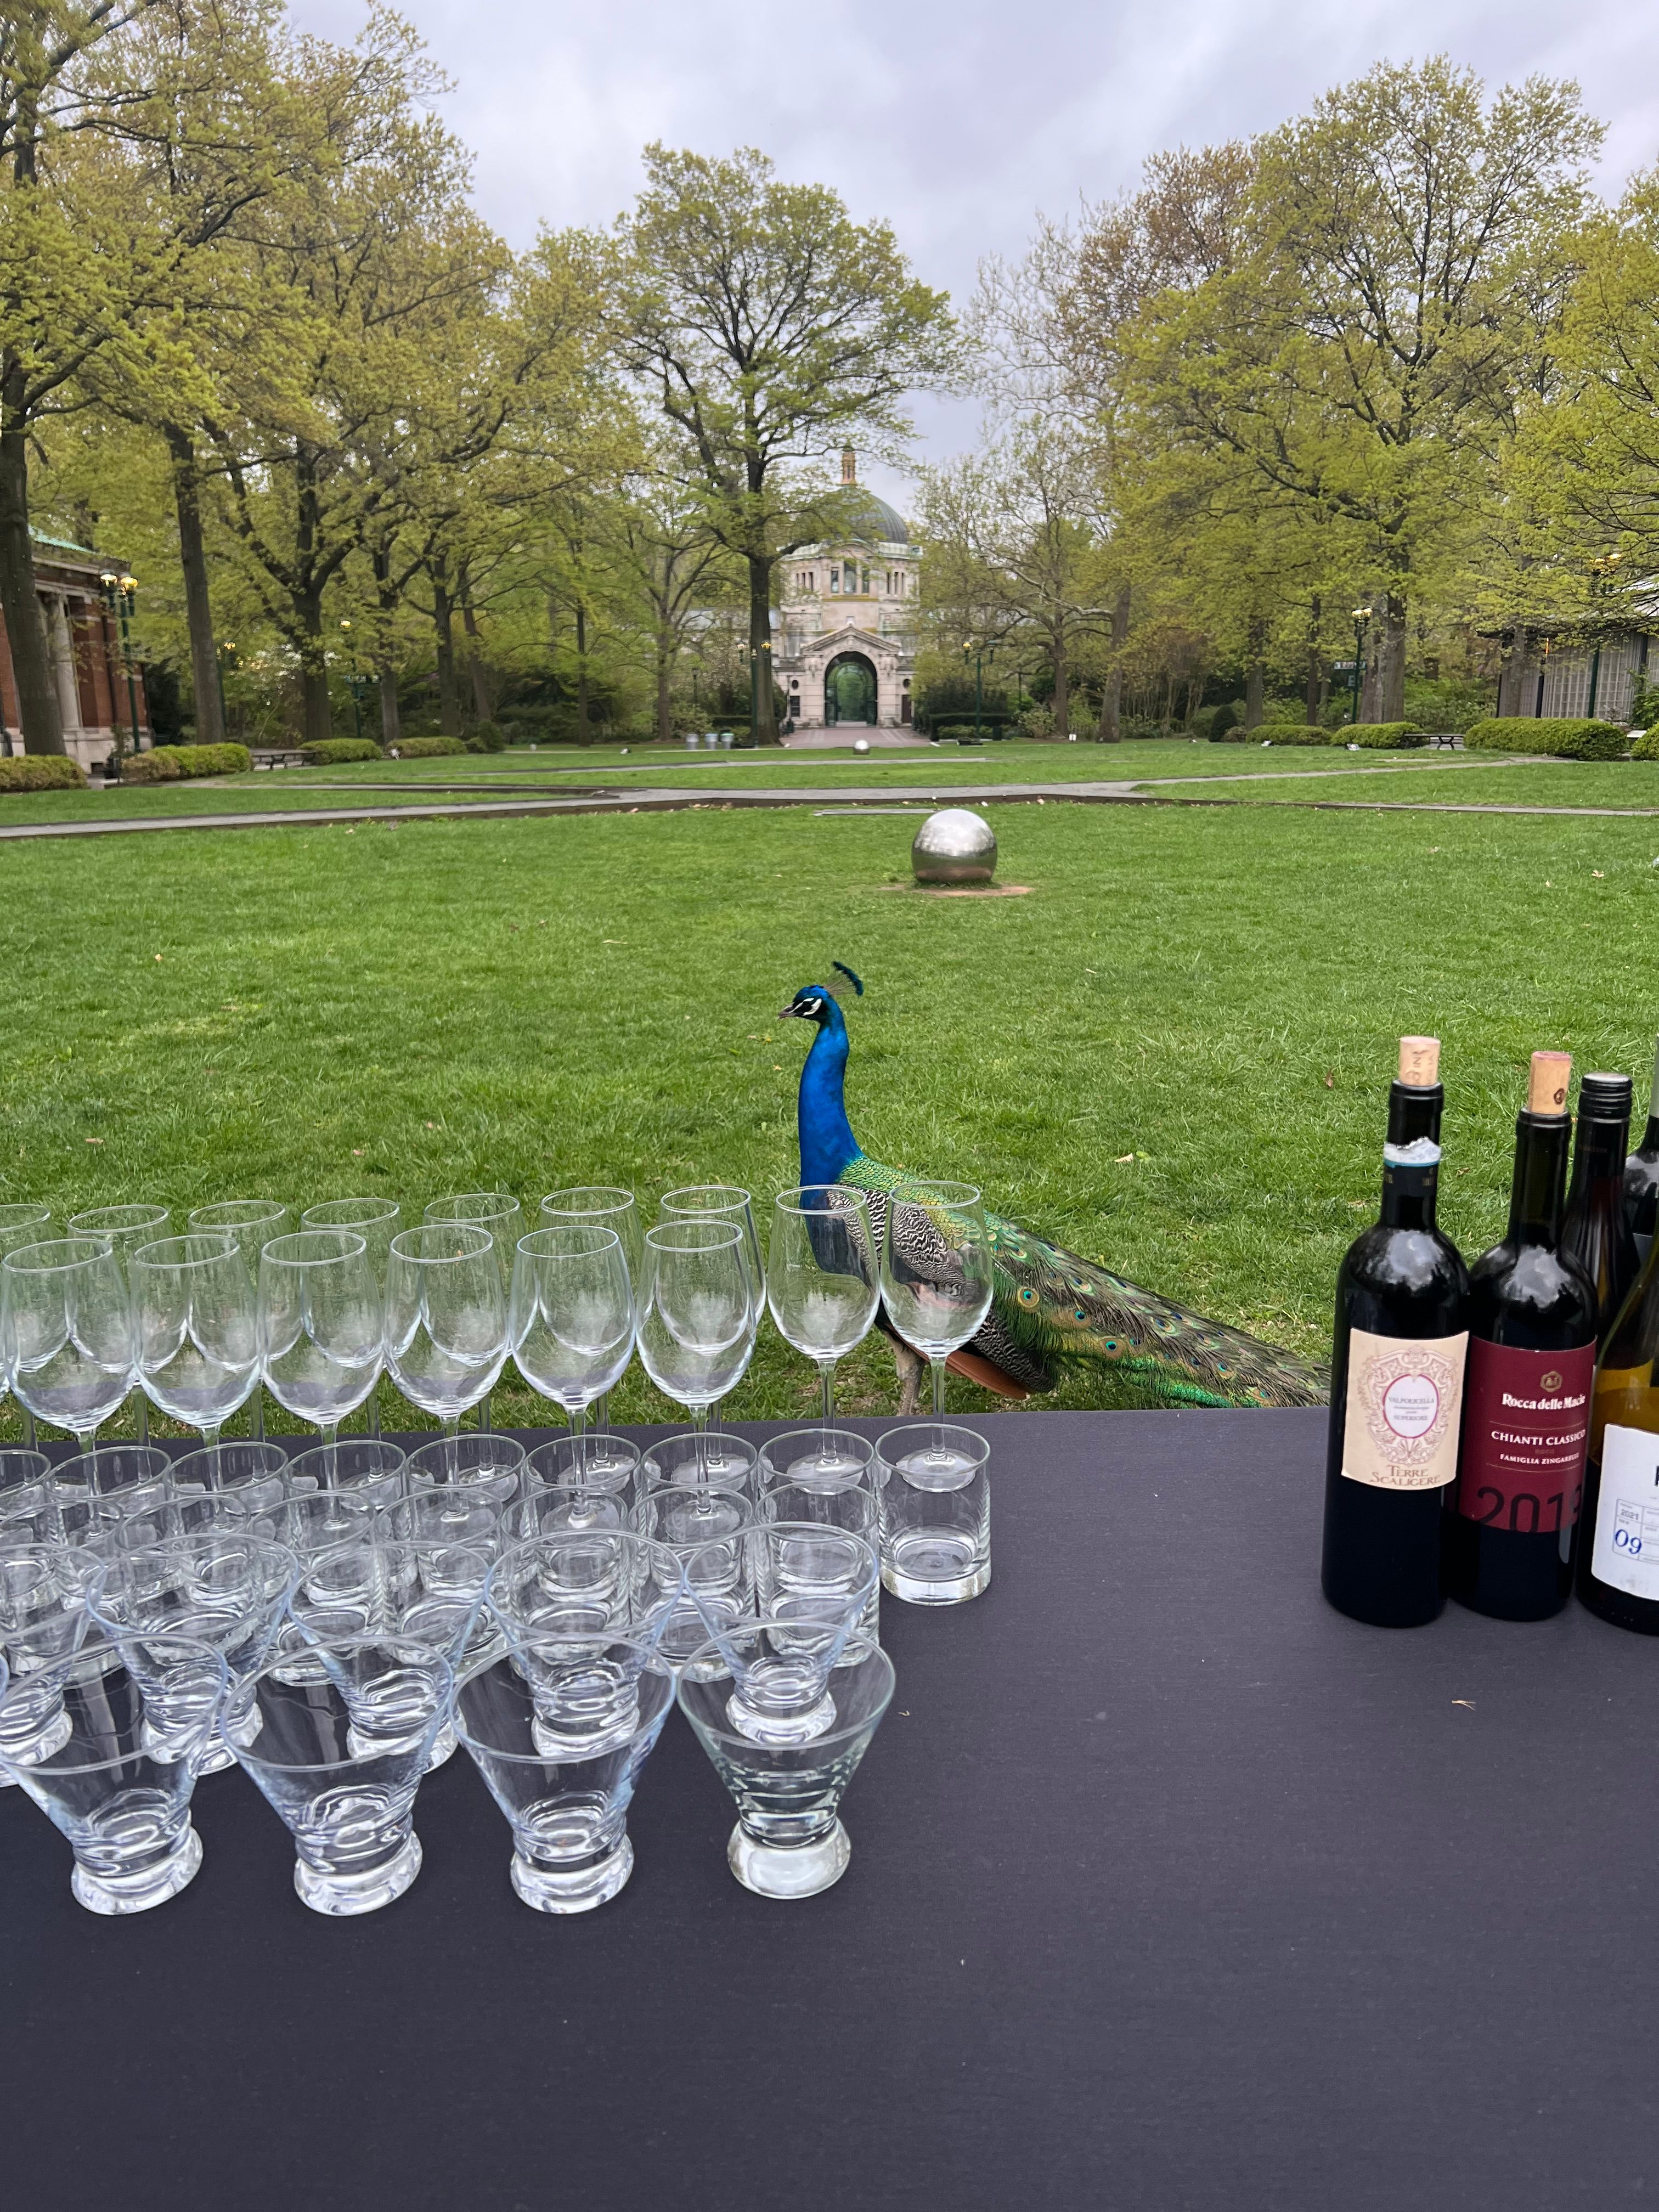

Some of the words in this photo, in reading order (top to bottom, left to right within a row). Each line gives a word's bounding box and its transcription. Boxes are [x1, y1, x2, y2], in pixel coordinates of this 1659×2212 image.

[1502, 1393, 1537, 1410] Rocca
[1537, 1398, 1562, 1410] delle
[1491, 1430, 1543, 1446] CHIANTI
[1545, 1429, 1586, 1446] CLASSICO
[1500, 1453, 1539, 1464] FAMIGLIA
[1614, 1528, 1642, 1555] 09
